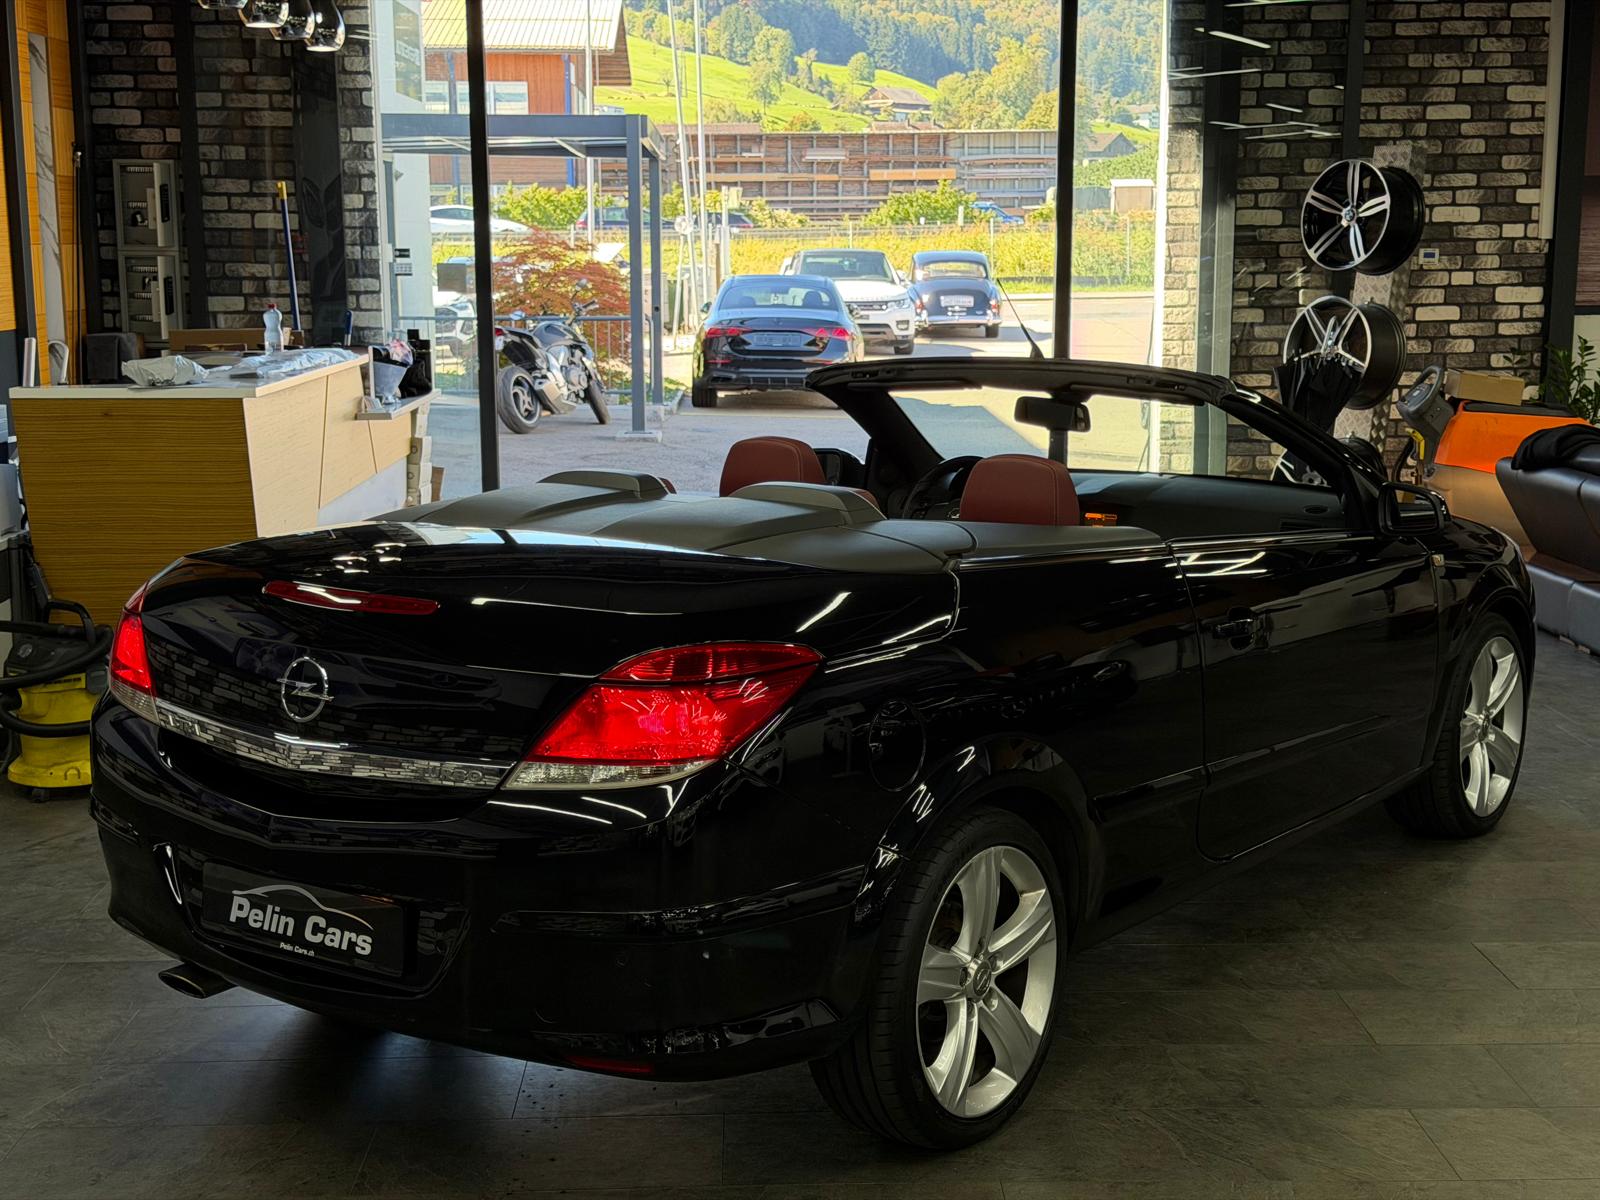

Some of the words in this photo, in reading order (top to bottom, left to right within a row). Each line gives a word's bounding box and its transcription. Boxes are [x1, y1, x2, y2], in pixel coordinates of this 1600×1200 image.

[229, 895, 295, 937] Pelin
[304, 914, 373, 956] Cars
[279, 941, 294, 952] Pelin
